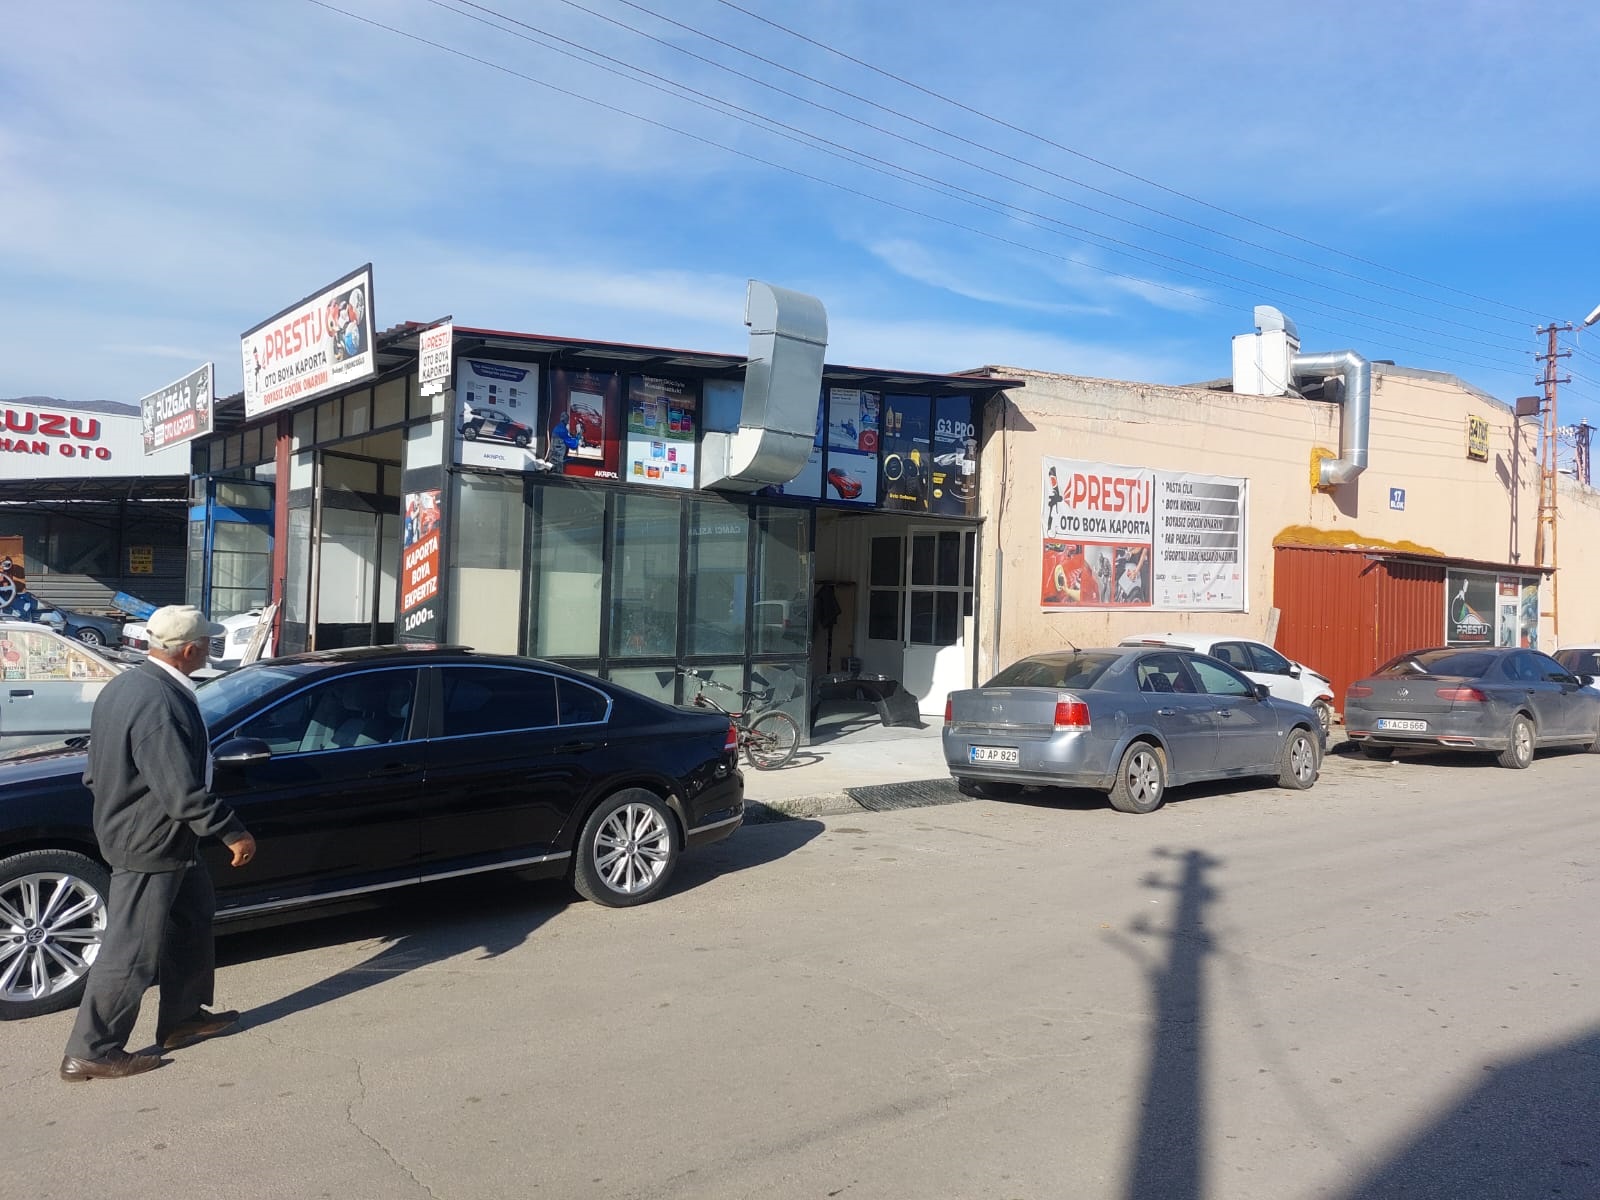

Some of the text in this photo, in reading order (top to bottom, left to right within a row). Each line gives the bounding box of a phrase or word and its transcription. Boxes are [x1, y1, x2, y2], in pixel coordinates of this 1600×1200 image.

[424, 351, 449, 367] OTO BOYA
[264, 371, 276, 388] OTO
[277, 366, 294, 383] BOYA
[295, 351, 327, 376] KAPORTA
[423, 363, 450, 380] KAPORTA
[0, 410, 98, 439] UZU
[937, 418, 952, 433] G3
[954, 422, 975, 438] PRO
[59, 443, 109, 460] OTO
[1166, 482, 1181, 493] PASTA
[1165, 499, 1179, 510] BOYA
[1060, 515, 1150, 535] OTO BOYA KAPORTA
[1165, 533, 1175, 545] FAR
[405, 535, 439, 570] KAPORTA
[411, 561, 431, 586] BOYA
[987, 750, 999, 760] AP
[1000, 750, 1017, 761] 829
